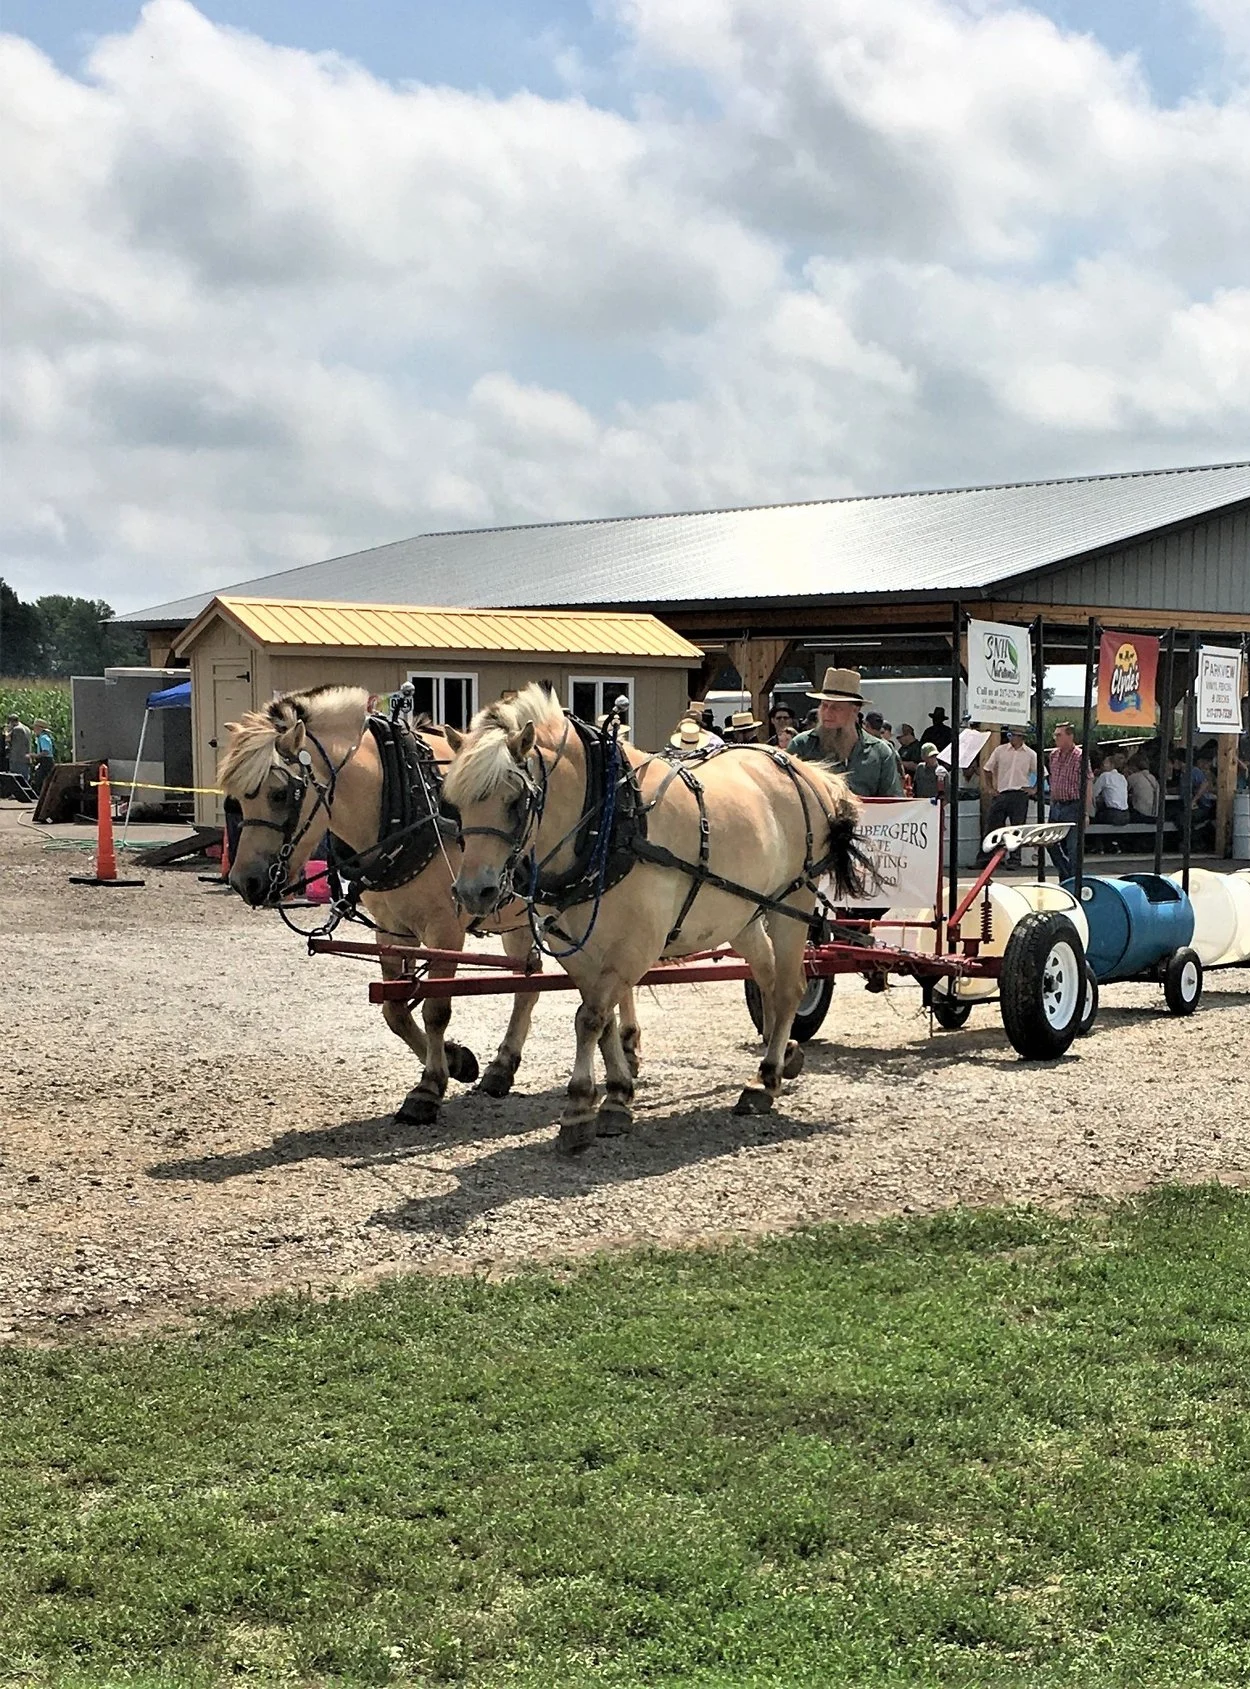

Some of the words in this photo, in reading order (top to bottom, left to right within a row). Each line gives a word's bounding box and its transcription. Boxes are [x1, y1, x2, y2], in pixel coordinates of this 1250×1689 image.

[985, 635, 1008, 660] SNH
[1204, 660, 1236, 679] PARKVIEW
[1111, 664, 1140, 702] Clyde's
